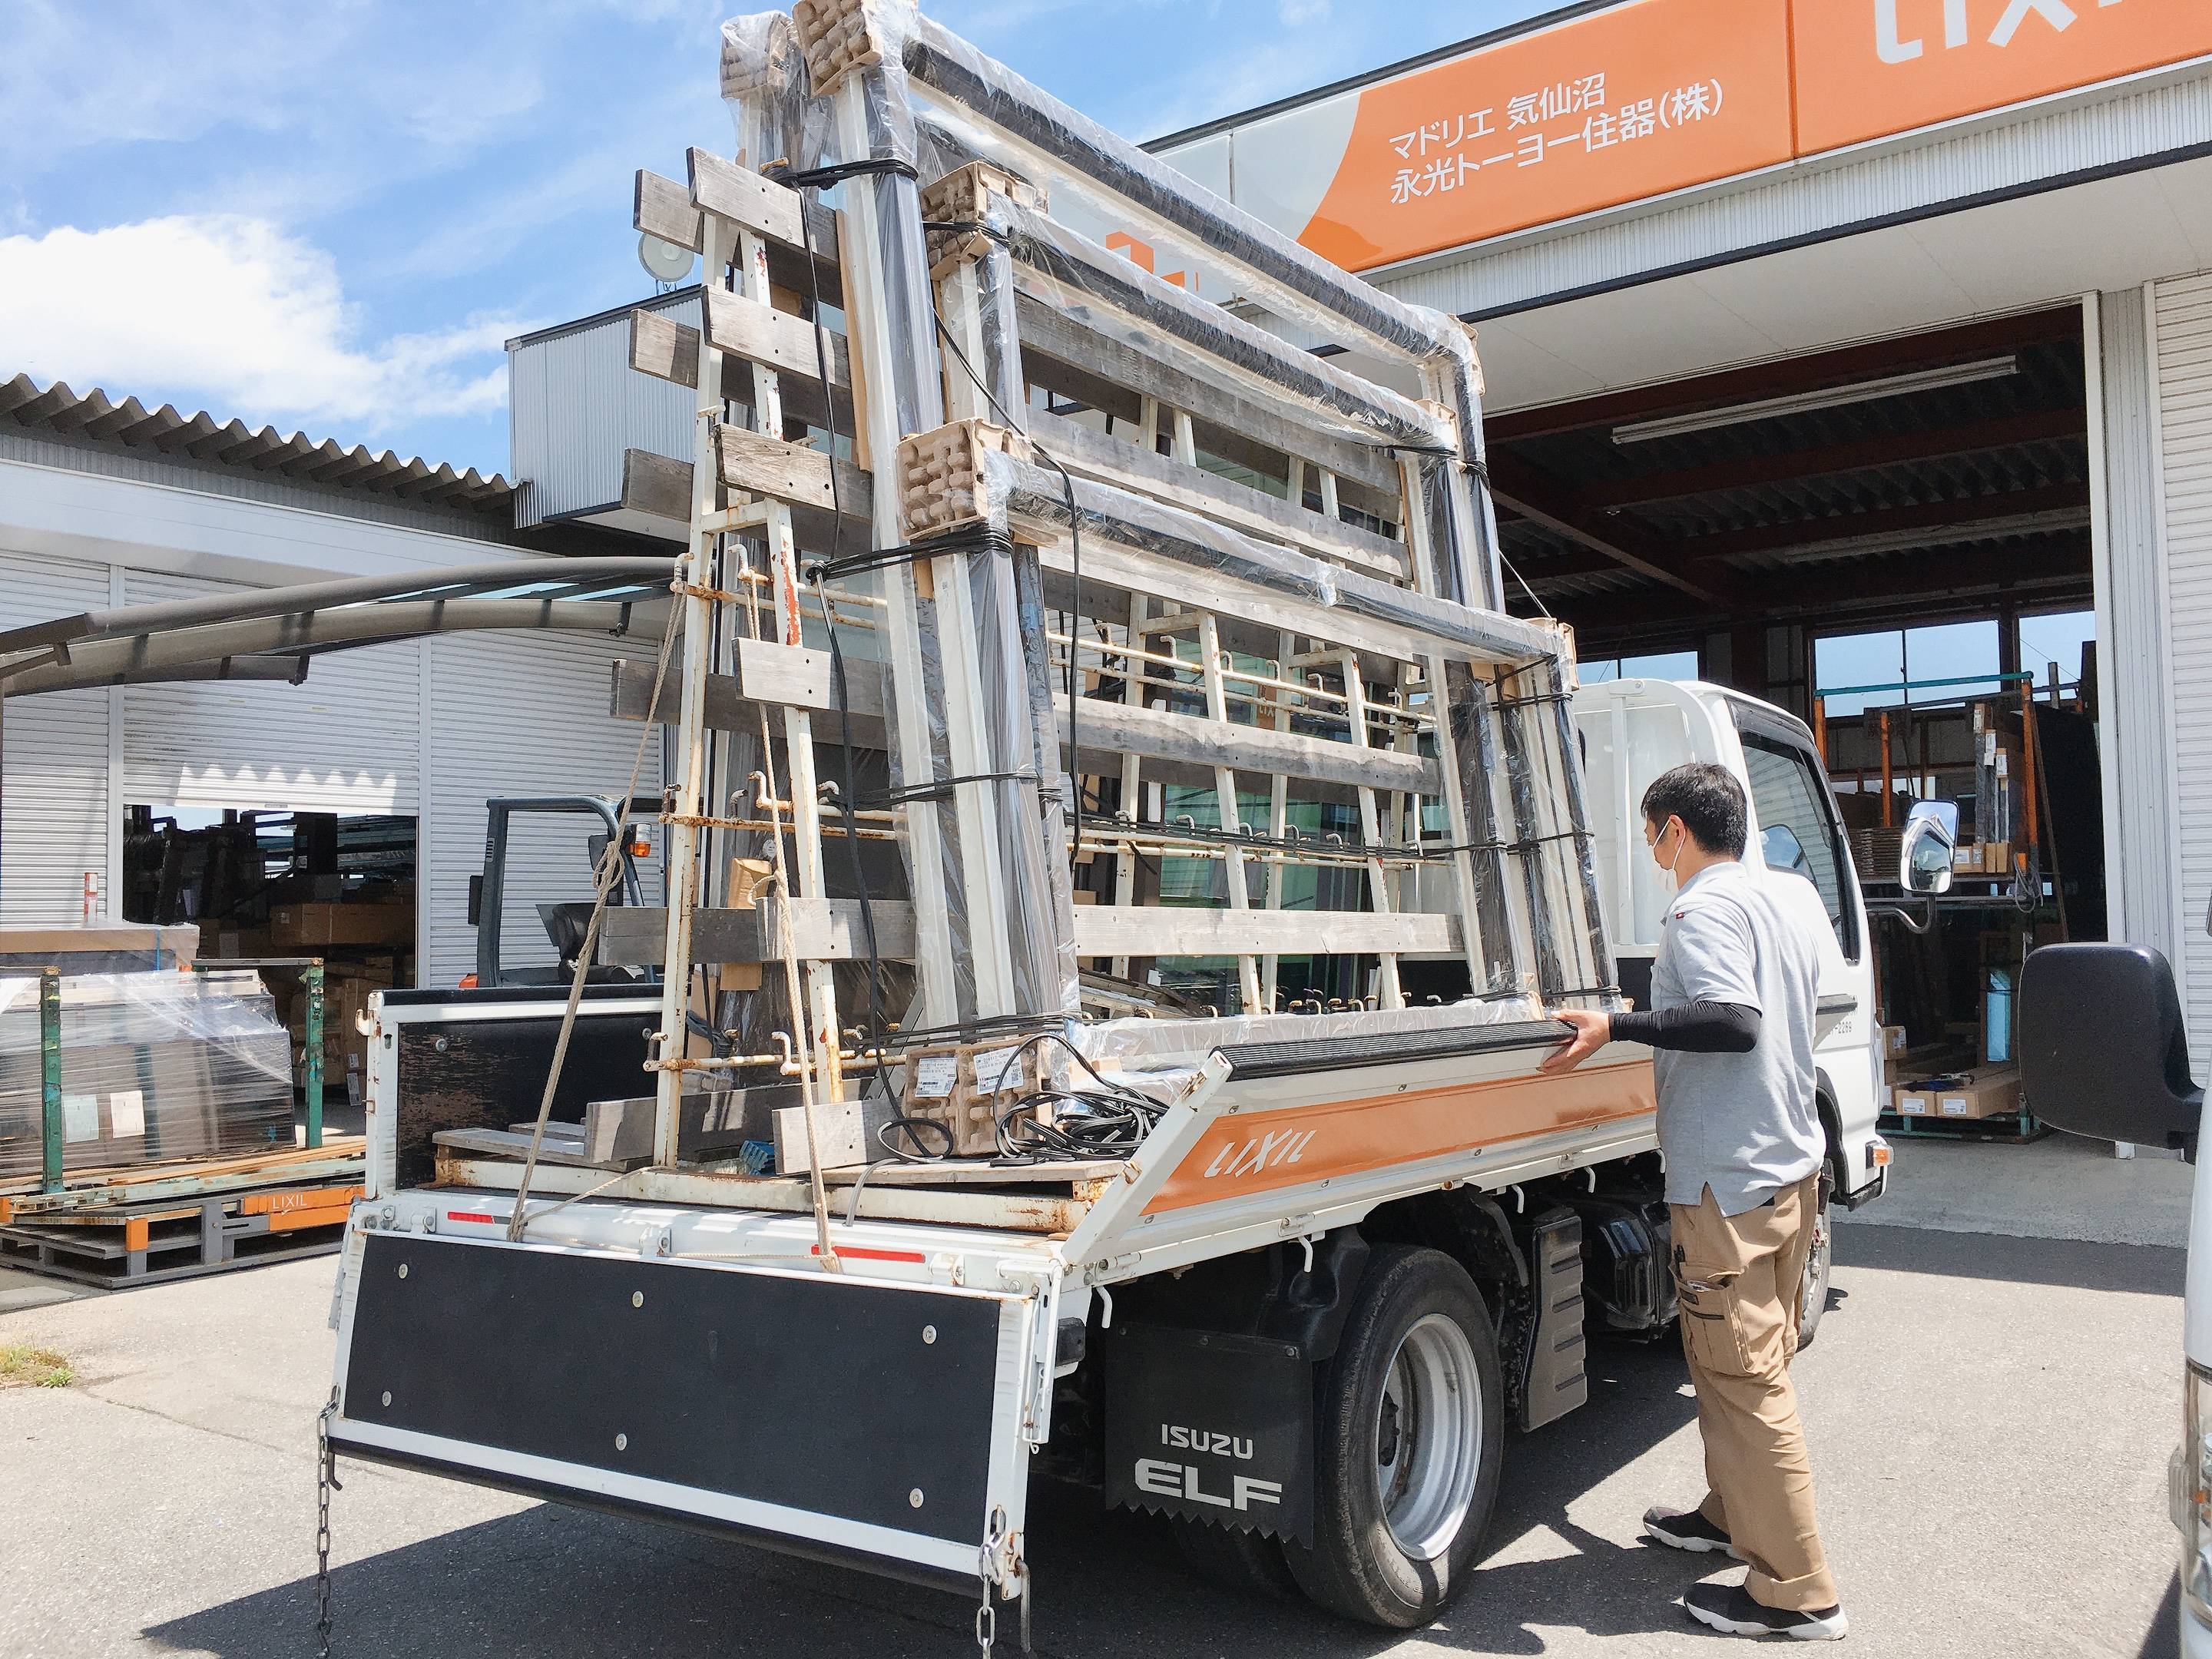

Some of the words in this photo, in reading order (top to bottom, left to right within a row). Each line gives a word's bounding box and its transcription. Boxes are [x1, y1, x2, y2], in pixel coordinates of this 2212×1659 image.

[1389, 108, 1496, 160] マドリエ
[1505, 71, 1606, 131] 気仙沼
[1389, 78, 1724, 205] 永光トーヨー住器(株)
[1204, 1128, 1317, 1178] LIXIL
[273, 1194, 307, 1210] LIXIL
[1161, 1423, 1253, 1460] ISUZU
[1134, 1458, 1282, 1512] ELF
